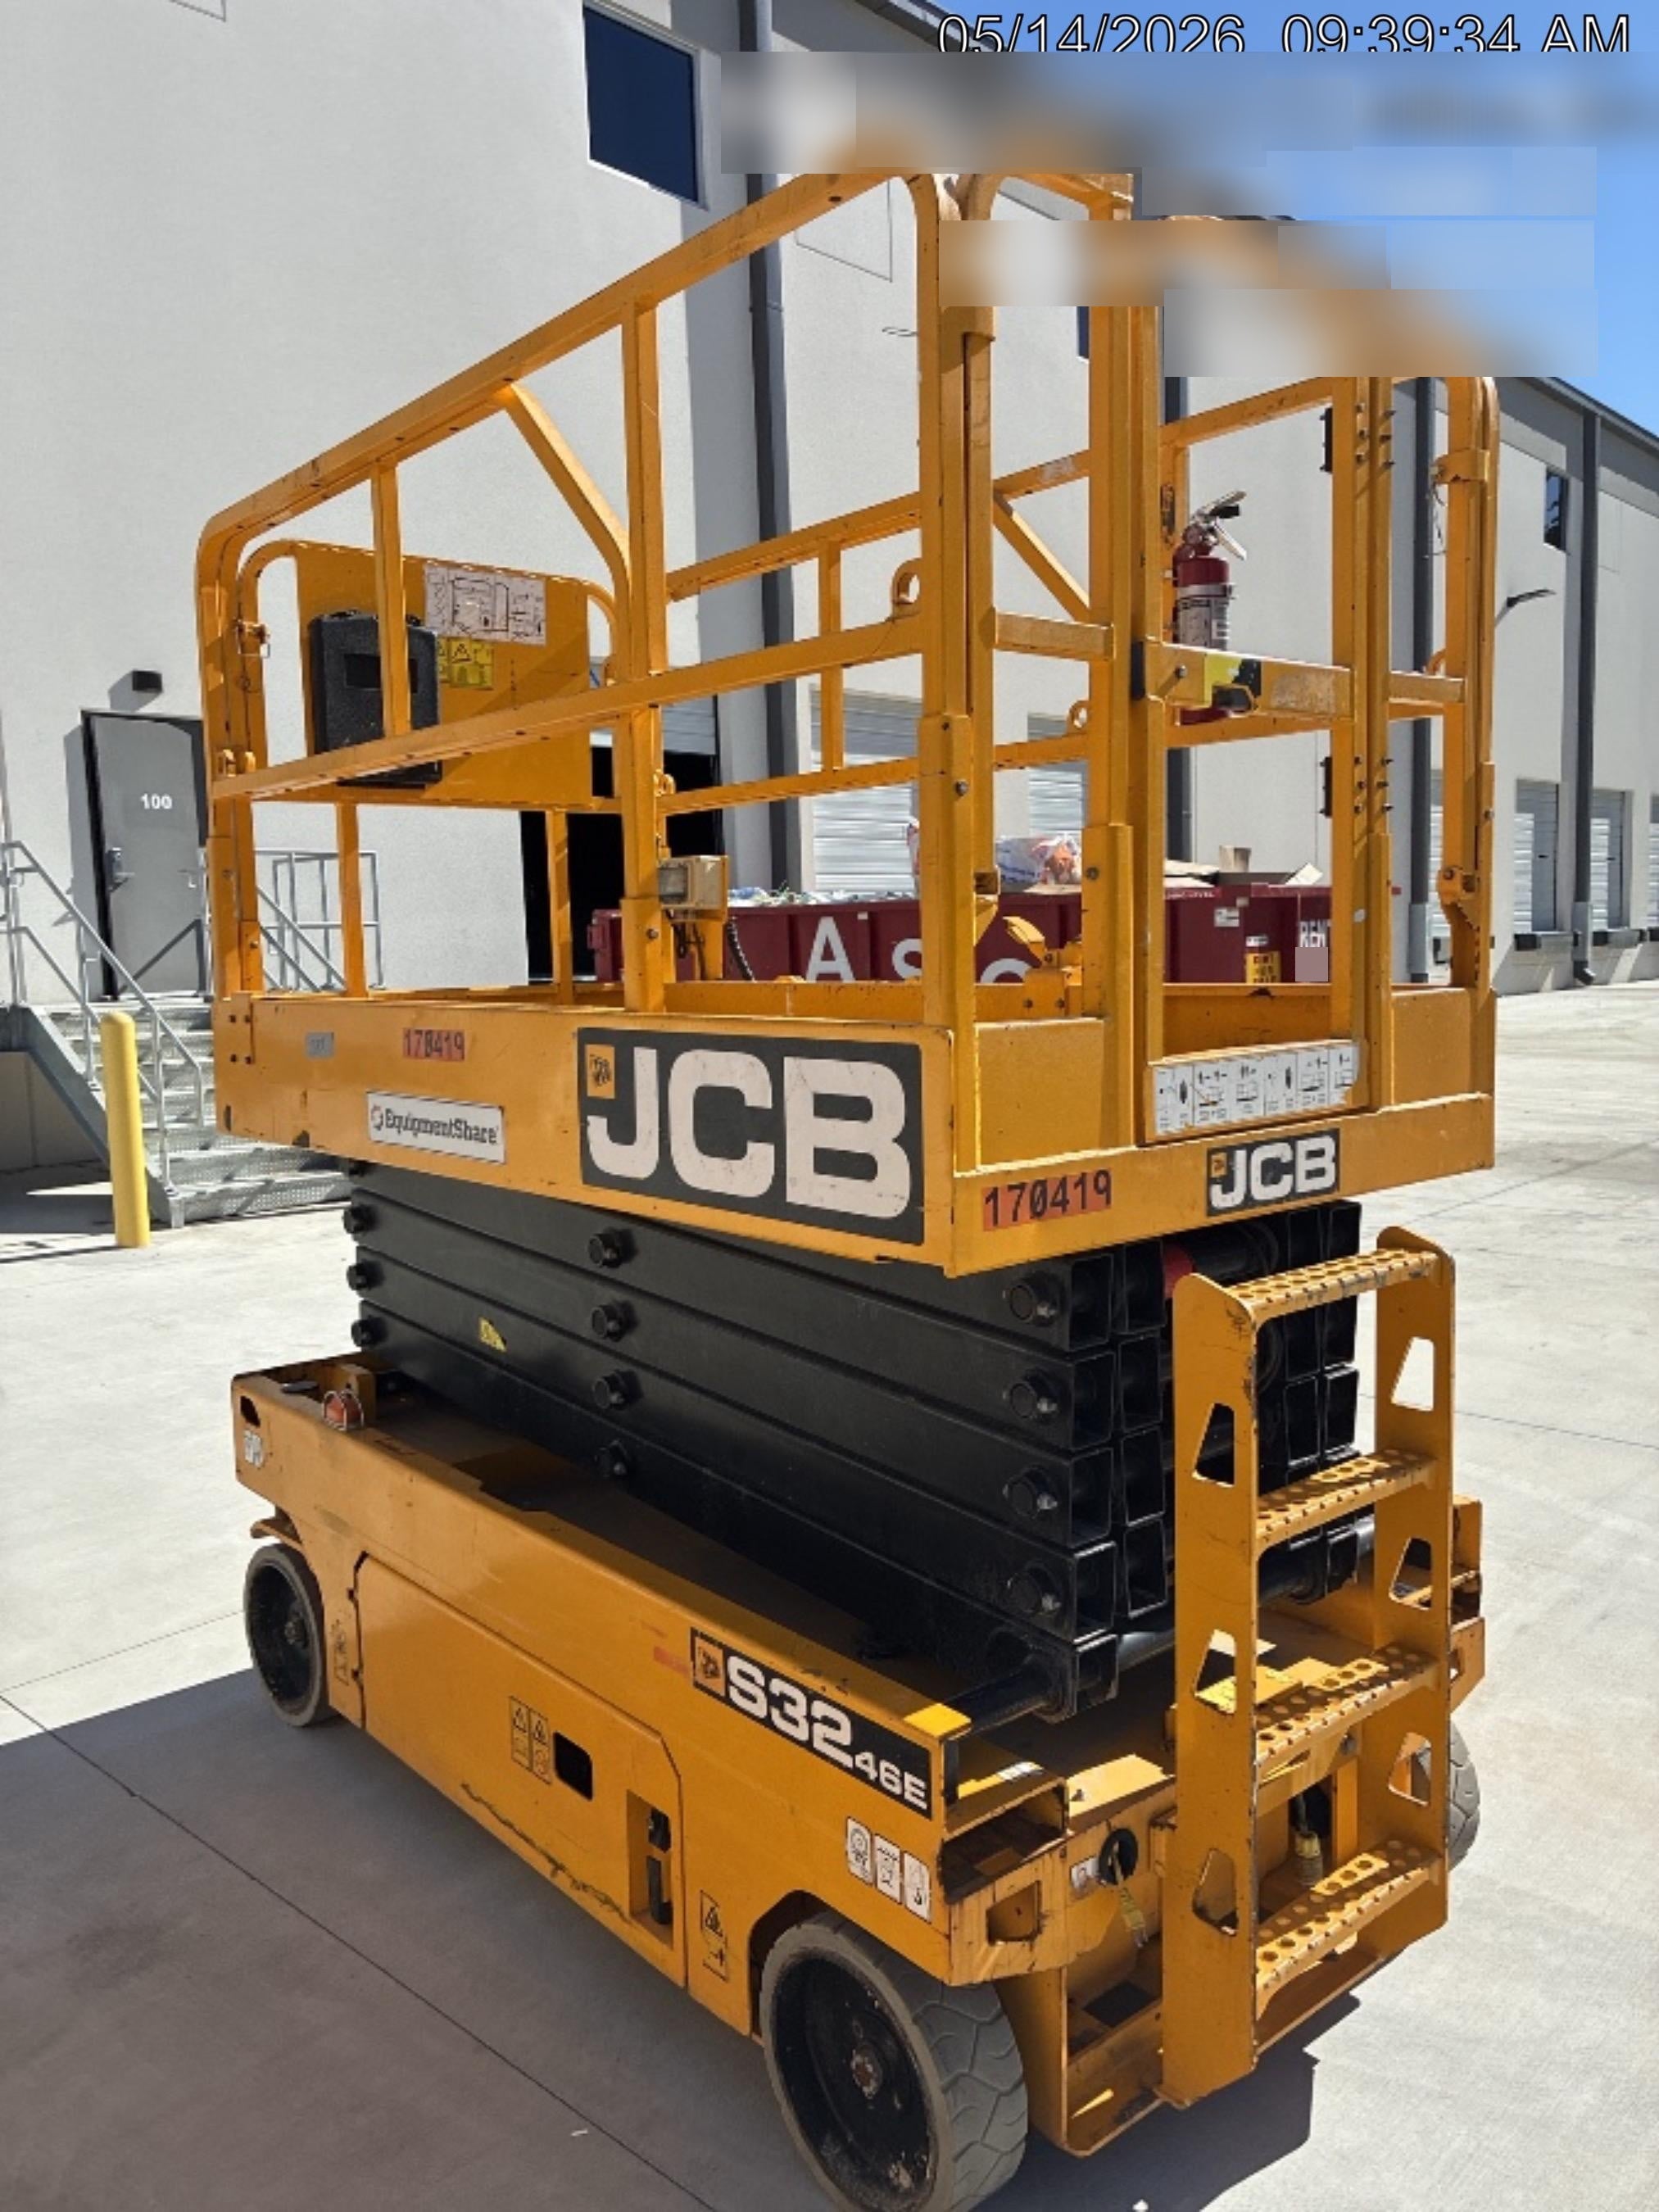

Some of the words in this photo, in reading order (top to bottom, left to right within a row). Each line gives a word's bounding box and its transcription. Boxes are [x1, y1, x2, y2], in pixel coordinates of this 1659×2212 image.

[141, 792, 173, 809] 100
[384, 1108, 498, 1145] EquipmentShare
[587, 1045, 910, 1219] JCB
[985, 1169, 1113, 1227] 170419
[1210, 1135, 1336, 1209] JCB
